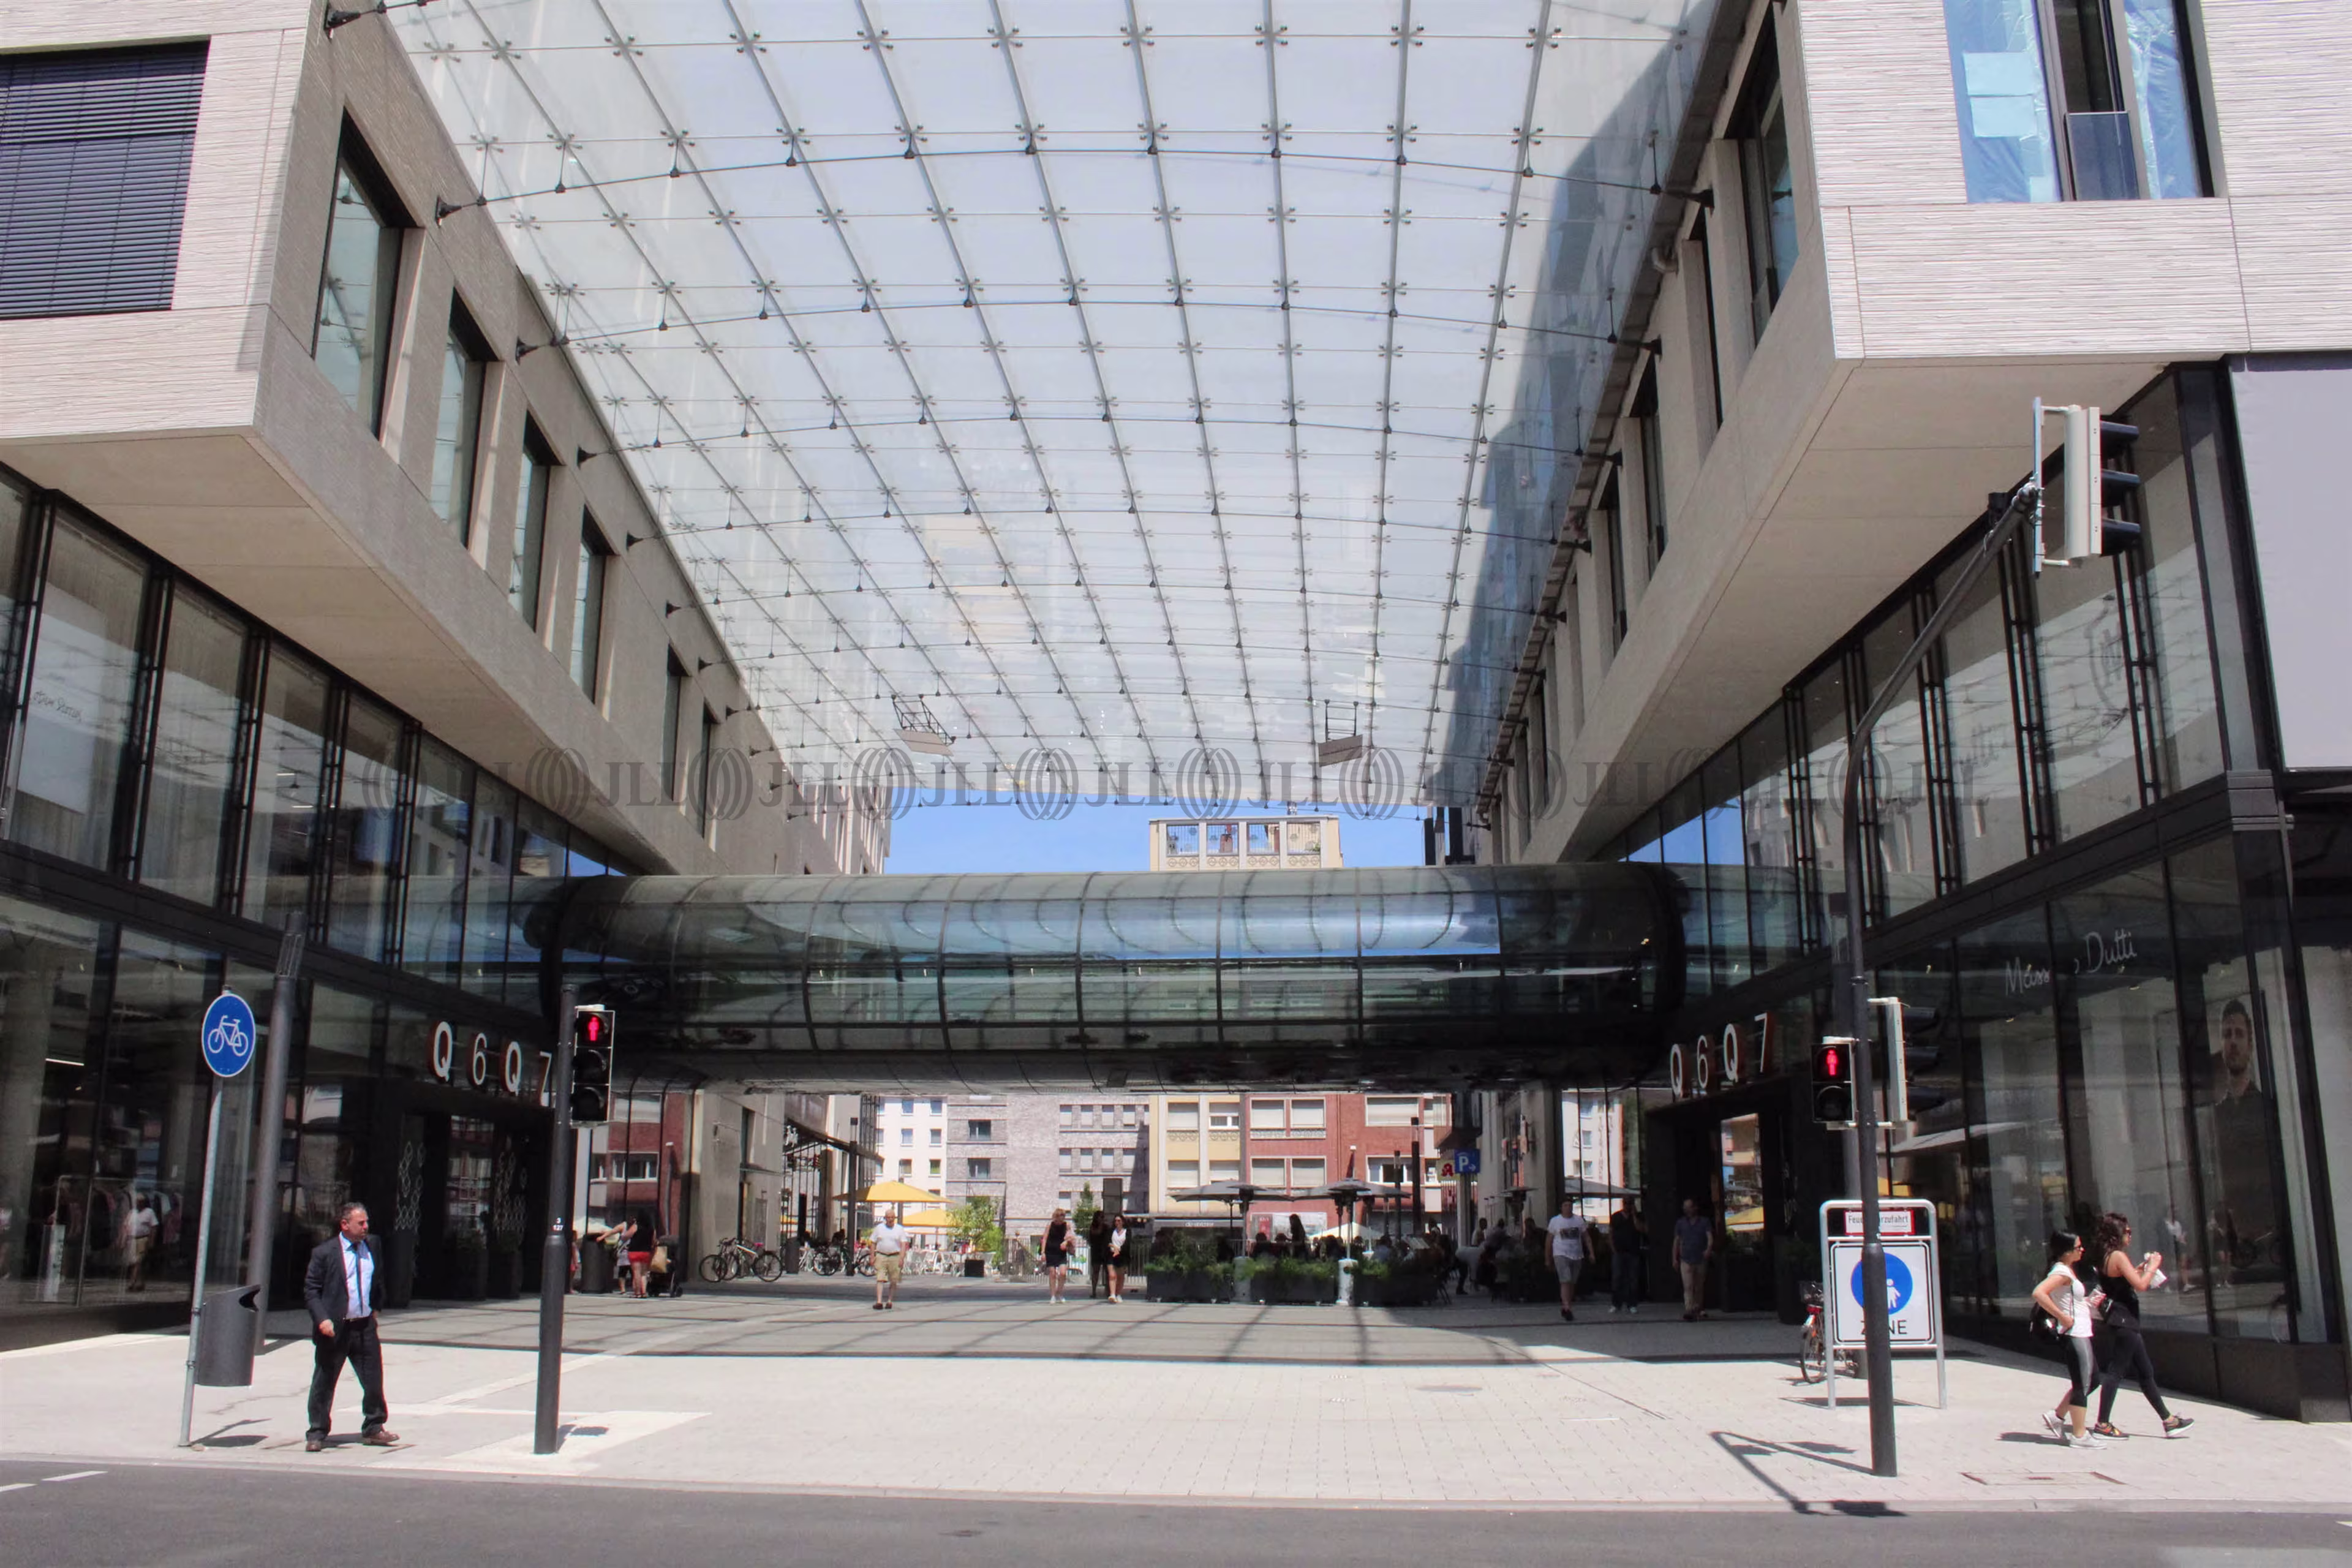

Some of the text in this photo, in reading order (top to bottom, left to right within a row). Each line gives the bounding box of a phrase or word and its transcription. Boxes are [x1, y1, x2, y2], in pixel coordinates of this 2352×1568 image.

[2084, 928, 2138, 973] Dutti
[1458, 1156, 1469, 1172] P
[1861, 1319, 1908, 1335] NE
